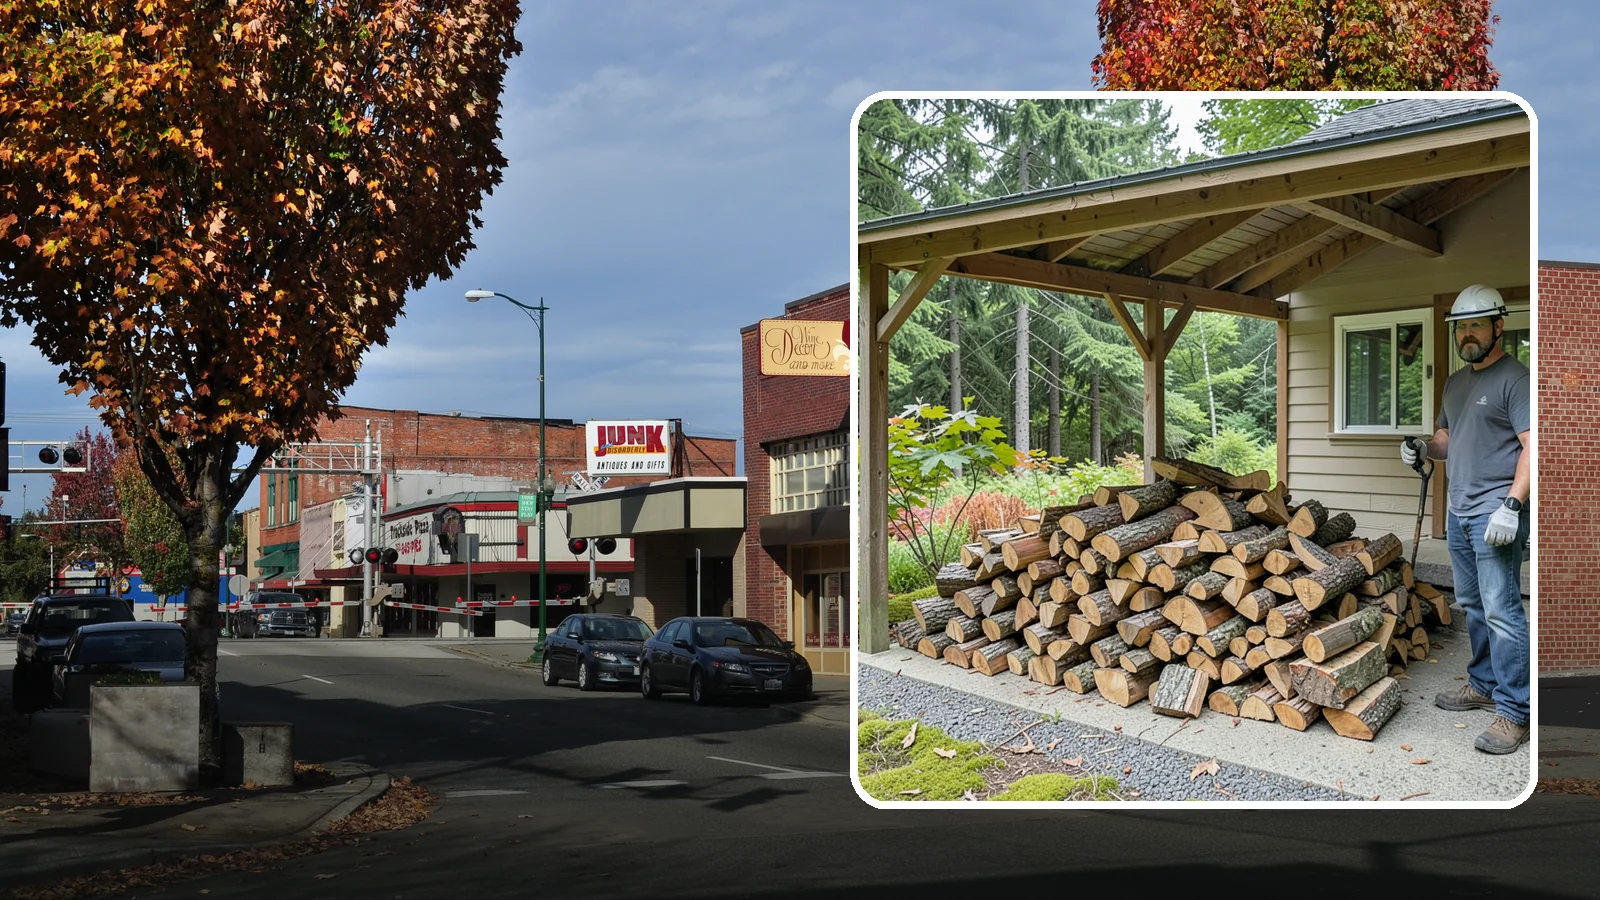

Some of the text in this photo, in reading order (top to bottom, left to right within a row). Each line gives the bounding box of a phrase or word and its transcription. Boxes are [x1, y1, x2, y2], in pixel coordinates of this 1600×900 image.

[596, 426, 665, 457] JUNK
[608, 446, 646, 454] DISORDERLY
[597, 460, 666, 470] ANTIQUES AND GIFTS
[415, 519, 429, 535] Pizza
